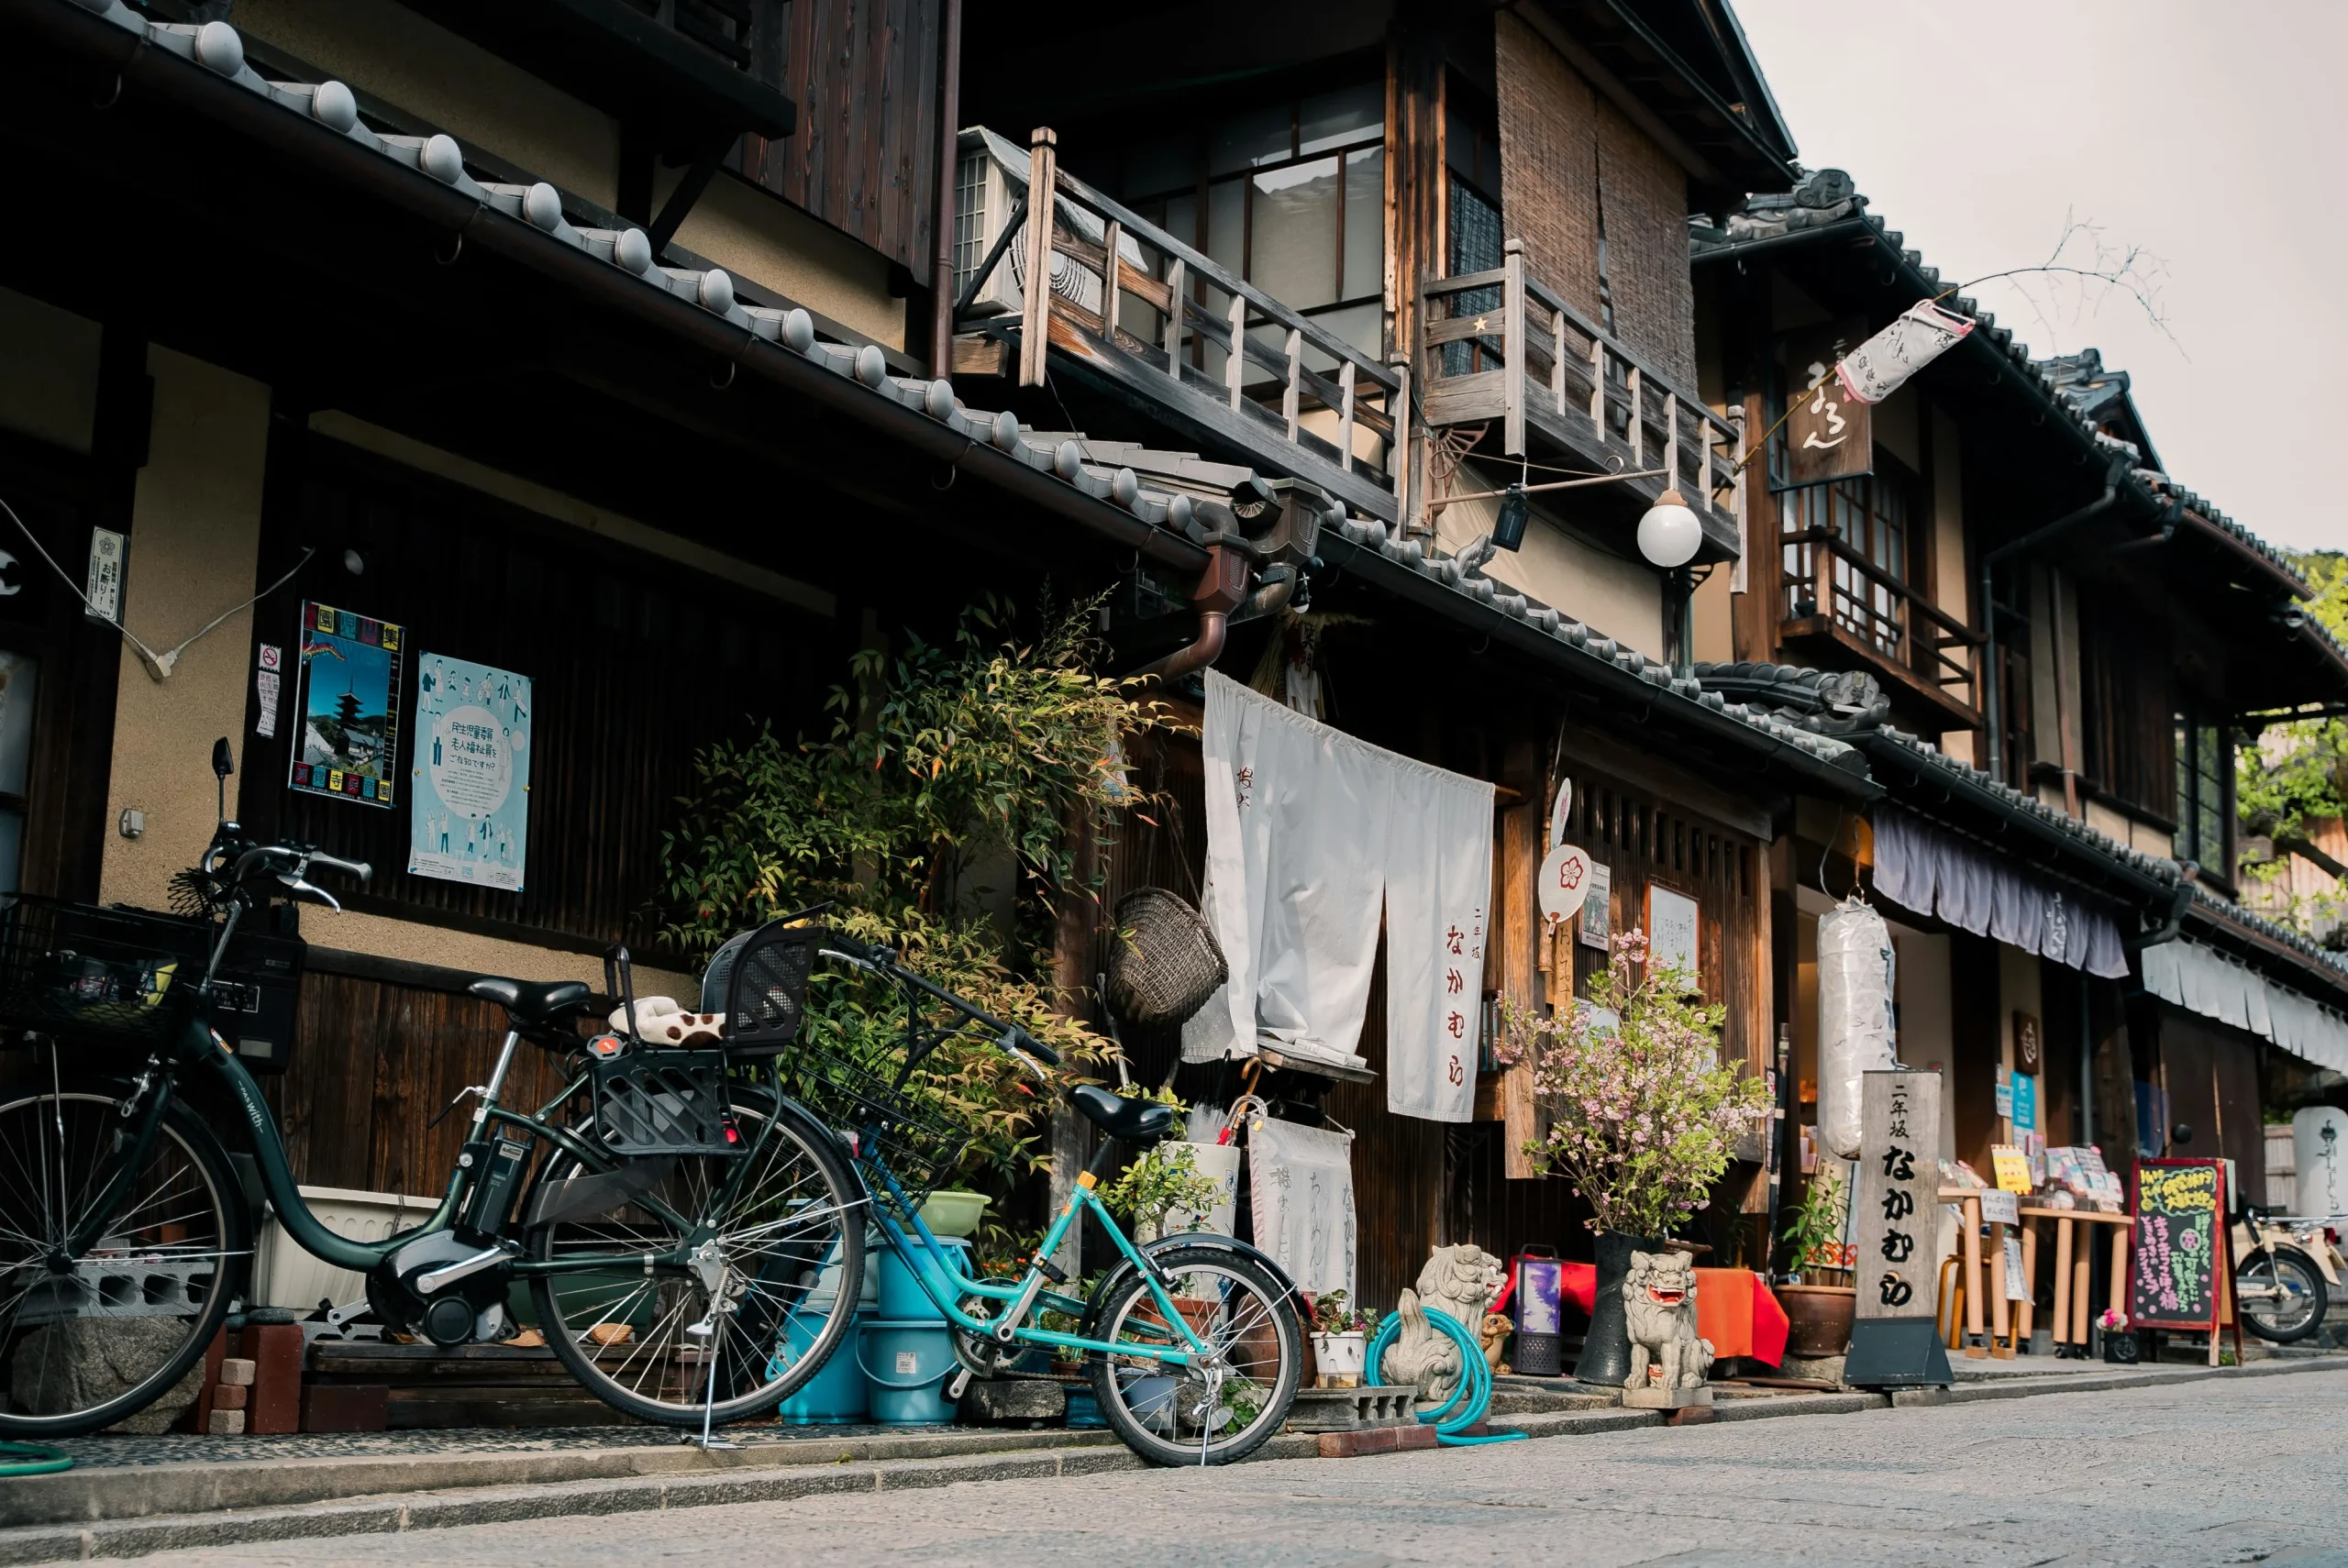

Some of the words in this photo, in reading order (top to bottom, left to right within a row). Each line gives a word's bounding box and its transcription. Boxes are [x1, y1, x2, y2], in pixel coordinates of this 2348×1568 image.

[451, 721, 493, 743] 民生児童委員
[451, 737, 497, 758] 老人福祉員を
[1471, 908, 1482, 960] 二年坂
[1446, 925, 1465, 1087] なかむら
[240, 1088, 250, 1103] PAS
[247, 1102, 263, 1127] with
[1889, 1085, 1910, 1139] 二年坂
[1878, 1144, 1915, 1307] なかむら
